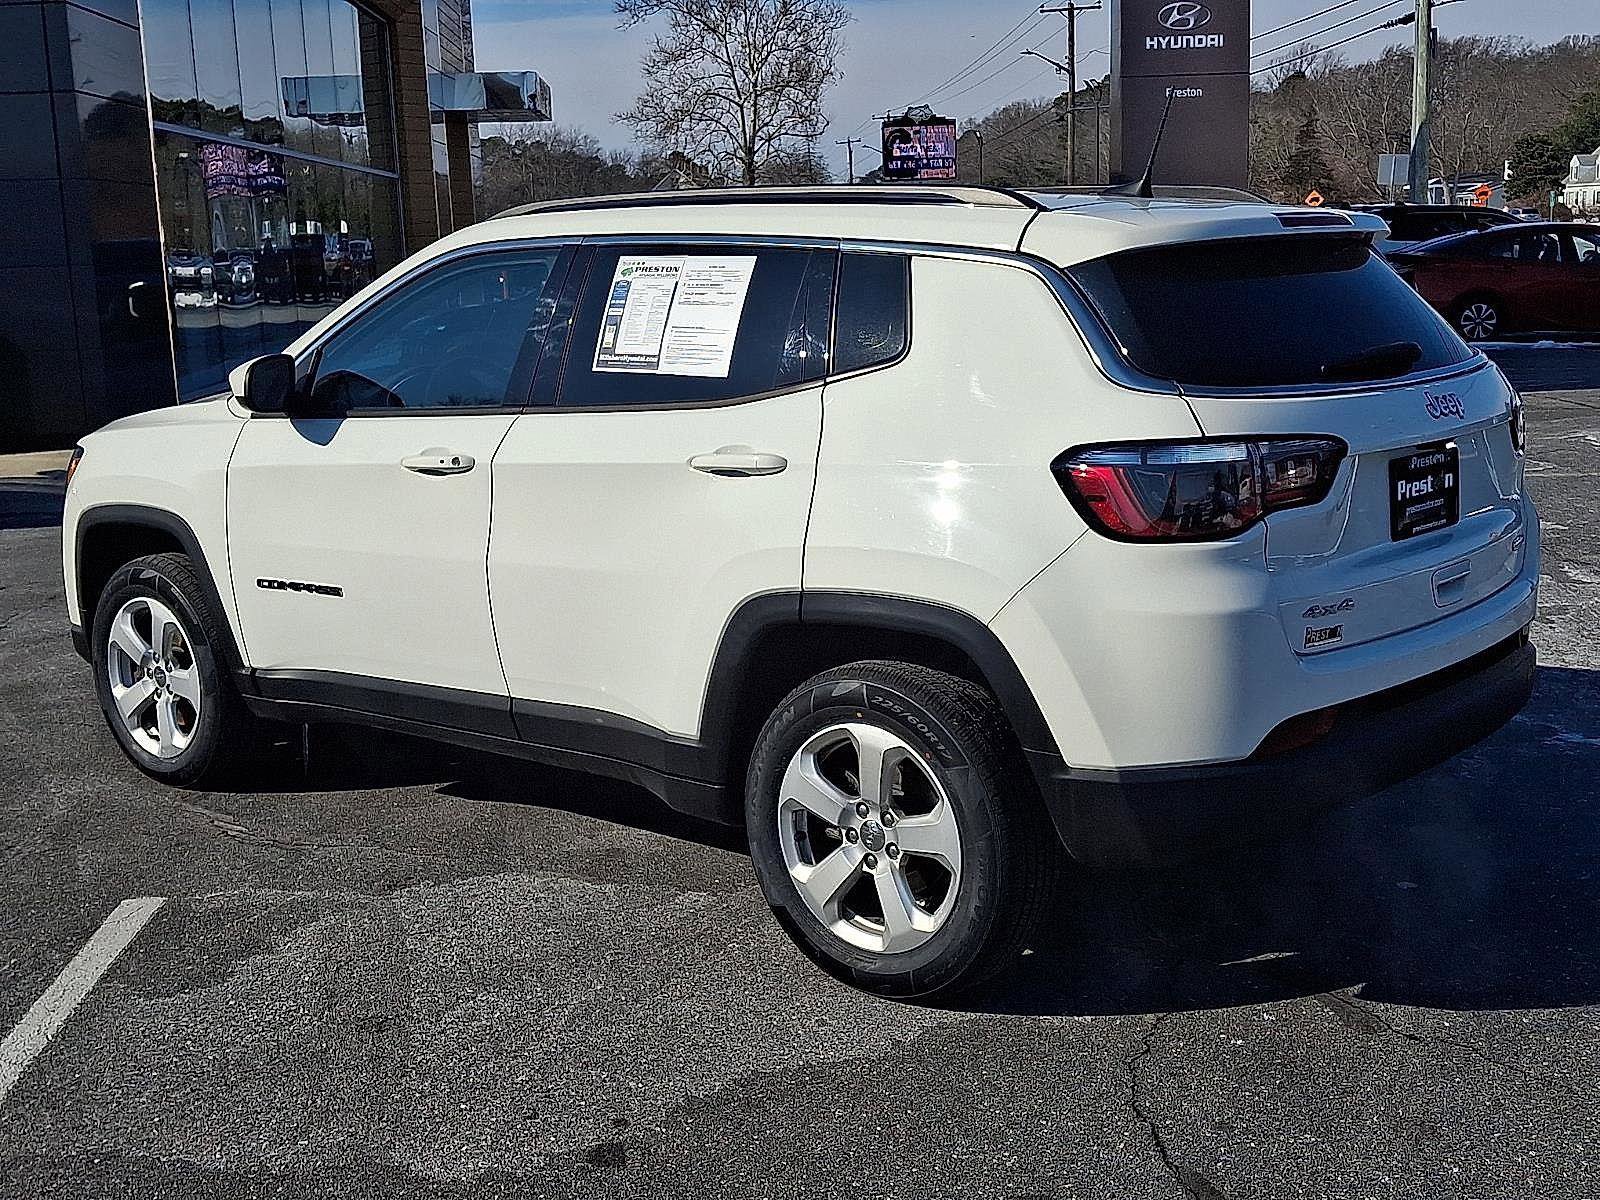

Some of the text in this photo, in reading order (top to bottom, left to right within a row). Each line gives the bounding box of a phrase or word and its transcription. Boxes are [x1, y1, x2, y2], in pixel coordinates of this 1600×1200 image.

[1145, 34, 1224, 50] HYUNDAI
[1424, 391, 1465, 420] Jeep
[1397, 472, 1453, 501] Prestn
[256, 578, 344, 597] COMPASS
